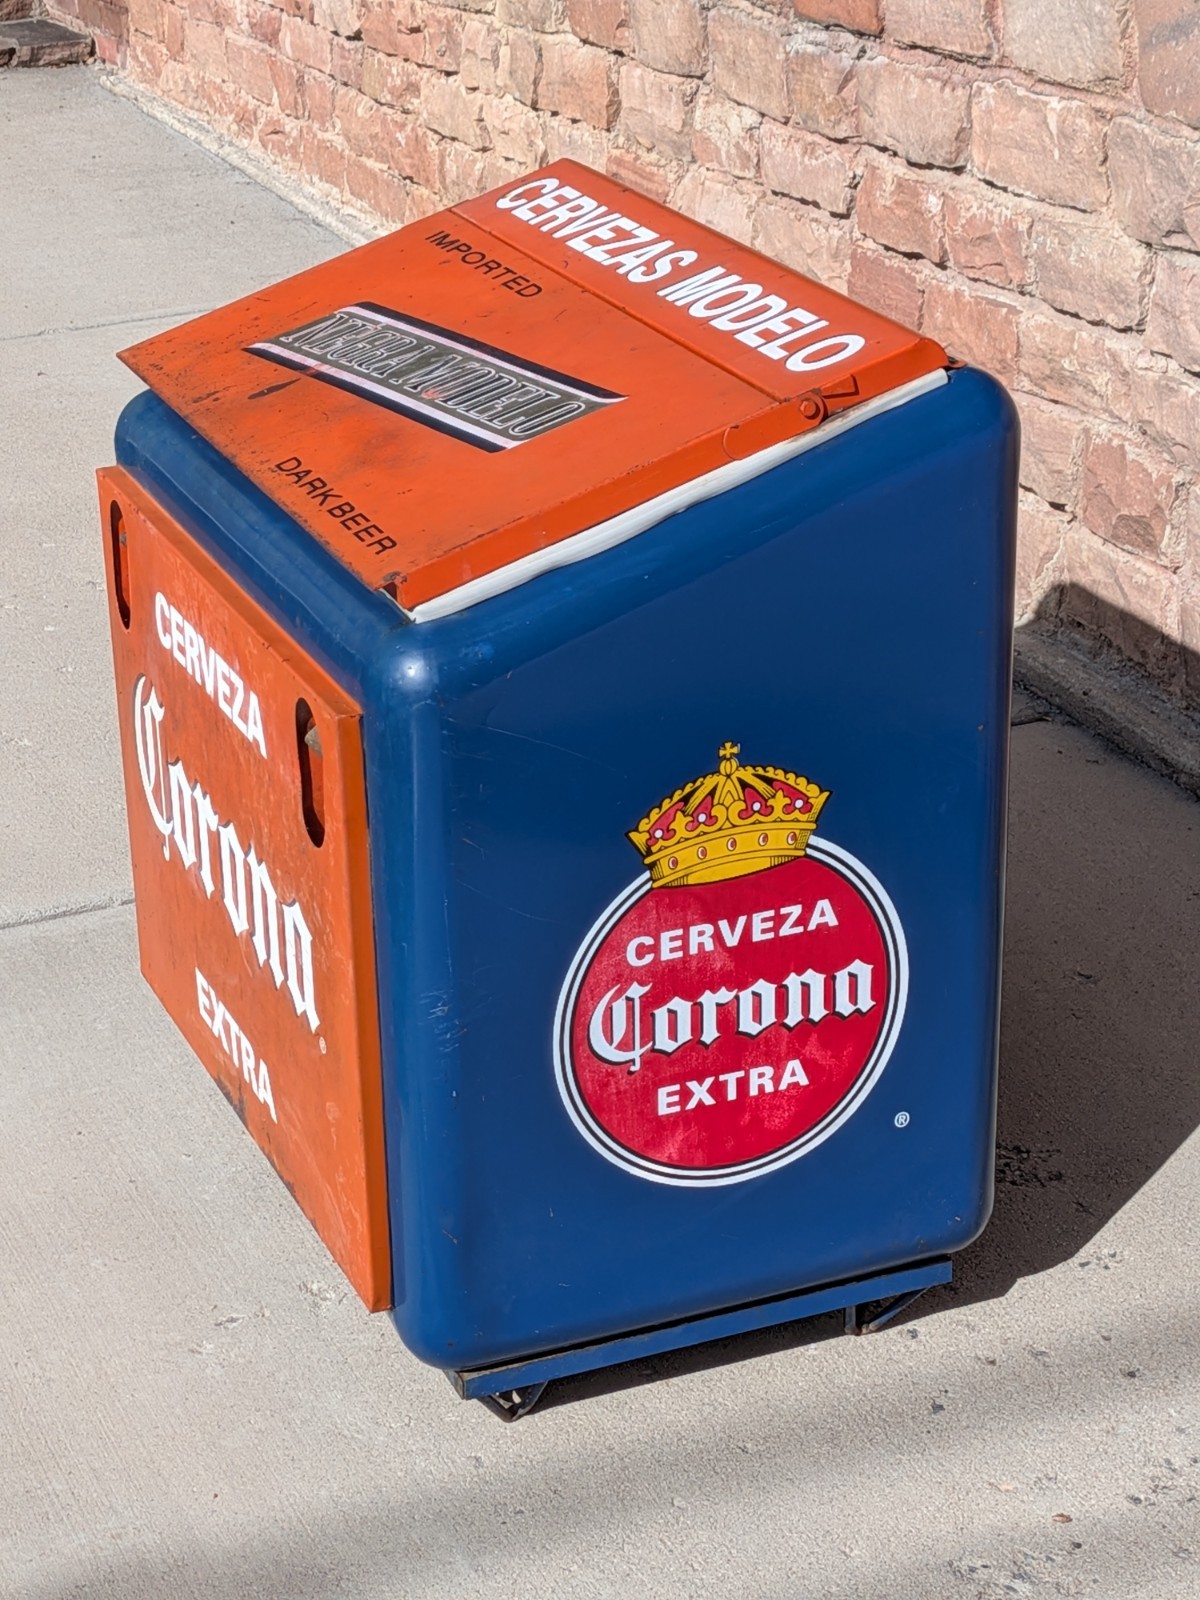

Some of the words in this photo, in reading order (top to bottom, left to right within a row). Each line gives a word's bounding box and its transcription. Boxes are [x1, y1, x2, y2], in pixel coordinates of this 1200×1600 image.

[425, 229, 543, 299] IMPORTED
[495, 177, 698, 284] CERVEZAS
[656, 265, 867, 373] MODELO
[279, 313, 436, 378] NEGRA
[388, 353, 586, 436] MODELO
[275, 456, 343, 507] DARK
[326, 501, 398, 555] BEER
[154, 590, 268, 760] CERVEZA
[133, 672, 320, 1035] Corona
[625, 898, 839, 968] CERVEZA
[194, 966, 277, 1124] EXTRA
[587, 958, 877, 1074] Corona
[656, 1059, 810, 1117] EXTRA
